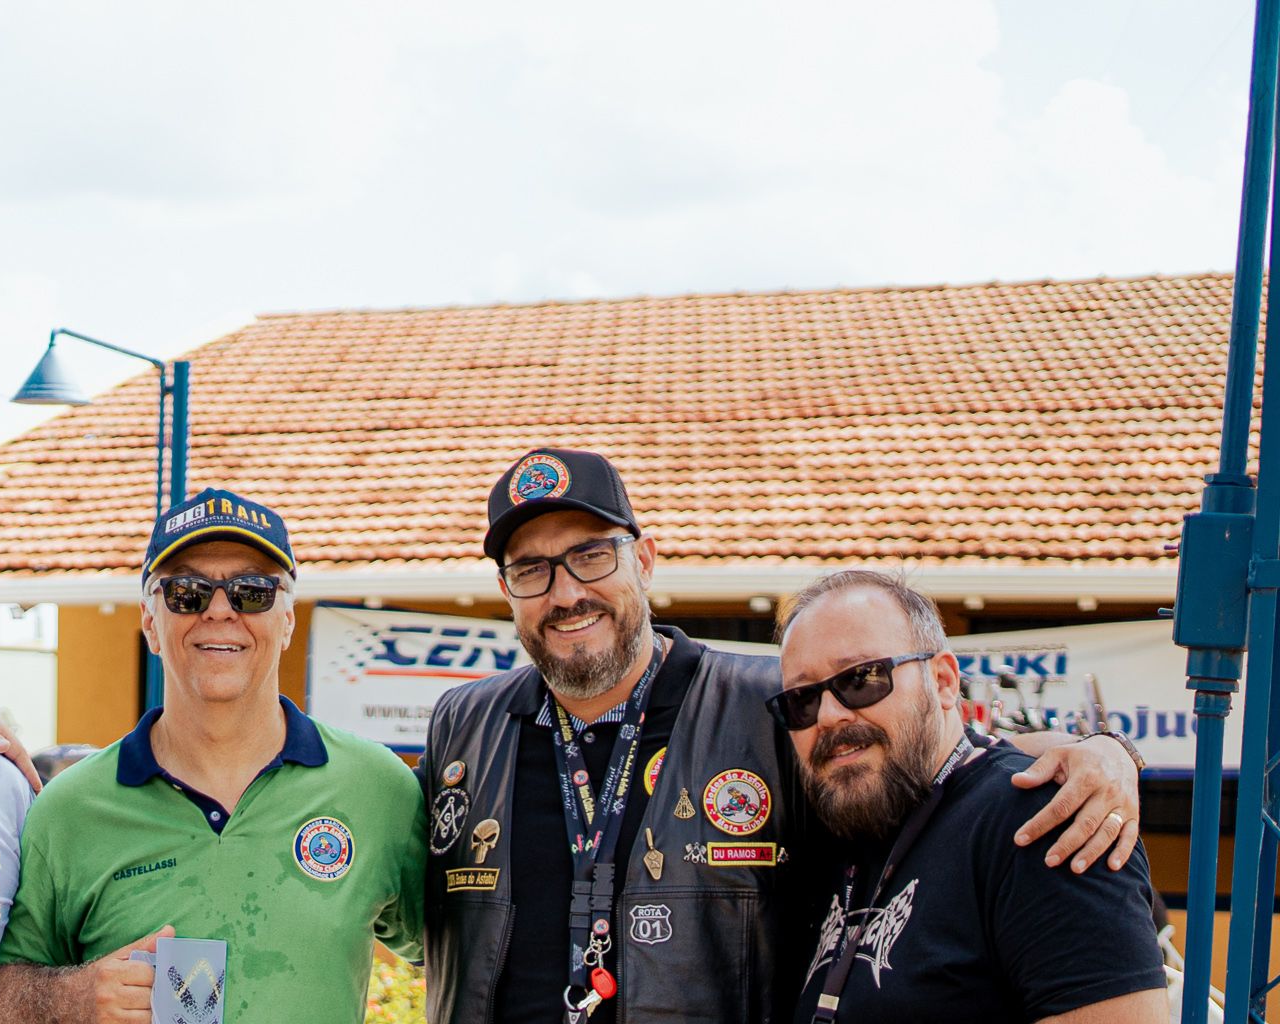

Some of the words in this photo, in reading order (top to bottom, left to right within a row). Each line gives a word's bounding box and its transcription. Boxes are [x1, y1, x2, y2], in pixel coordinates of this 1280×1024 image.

[168, 506, 202, 530] BIG
[206, 498, 271, 528] TRAIL
[706, 778, 724, 804] Bodes
[725, 772, 738, 780] do
[740, 772, 767, 800] Asfalto
[716, 818, 738, 832] Moto
[742, 815, 766, 832] Clube
[713, 849, 725, 858] DU
[727, 849, 756, 858] RAMOS
[113, 858, 177, 881] CASTELLASSI
[639, 920, 663, 938] 01
